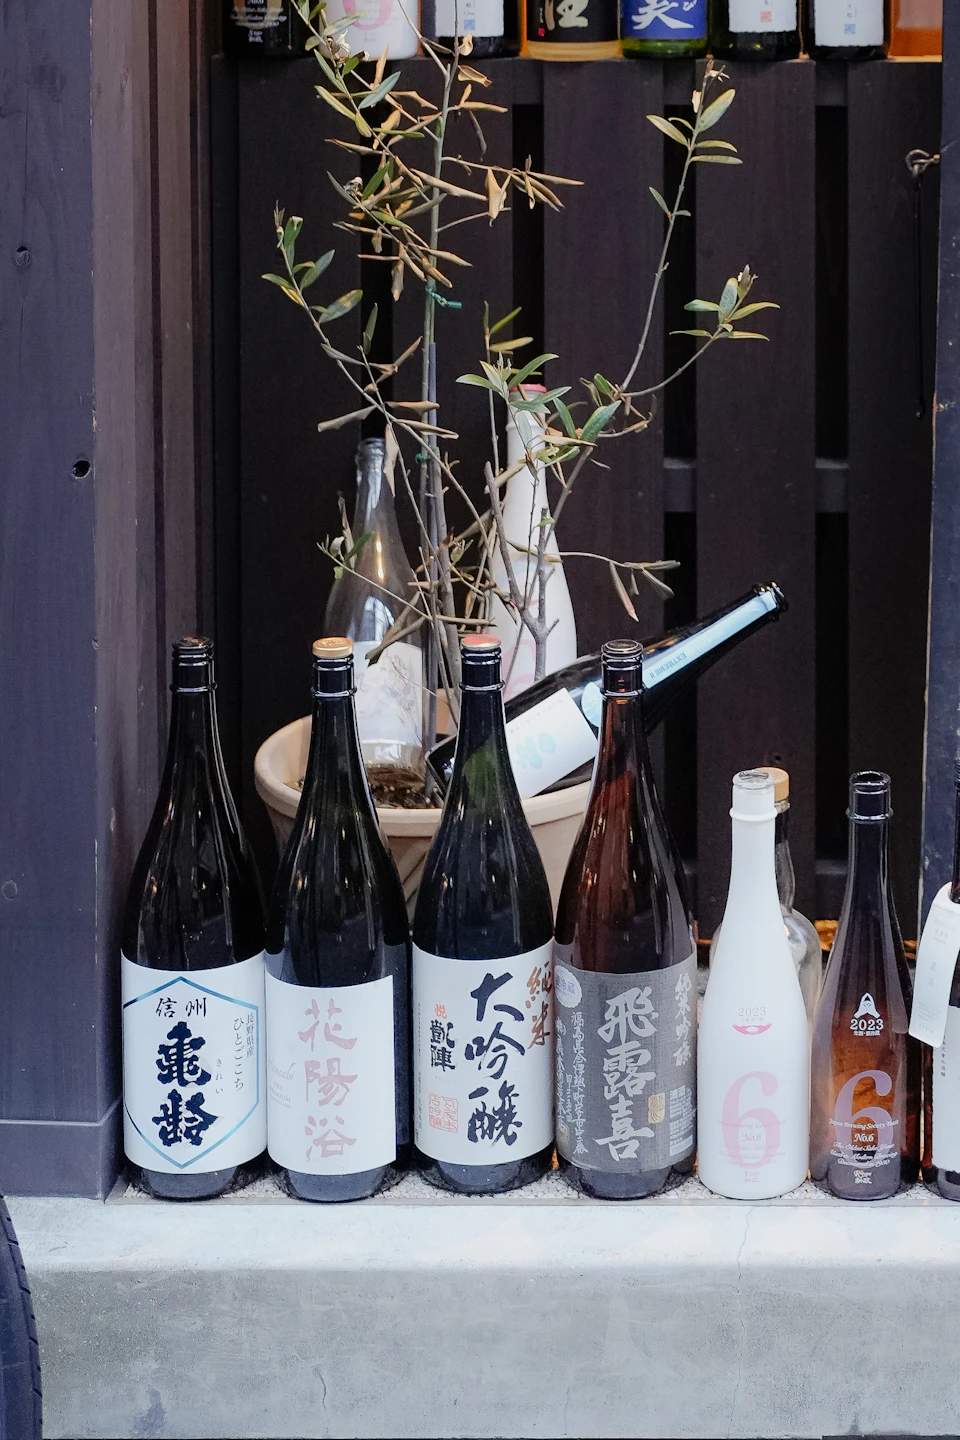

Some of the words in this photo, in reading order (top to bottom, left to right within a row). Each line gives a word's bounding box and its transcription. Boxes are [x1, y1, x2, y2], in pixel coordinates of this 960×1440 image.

[155, 997, 207, 1018] 信州
[738, 1006, 767, 1017] 2023
[850, 1019, 884, 1030] 2023
[215, 1059, 224, 1094] きれい
[233, 1018, 245, 1090] ひとごこち
[297, 998, 358, 1162] 花陽浴
[464, 972, 526, 1148] 大吟醸
[593, 987, 659, 1162] 飛露喜
[720, 1071, 782, 1169] 6
[834, 1069, 894, 1169] 6
[853, 1133, 875, 1143] No.6
